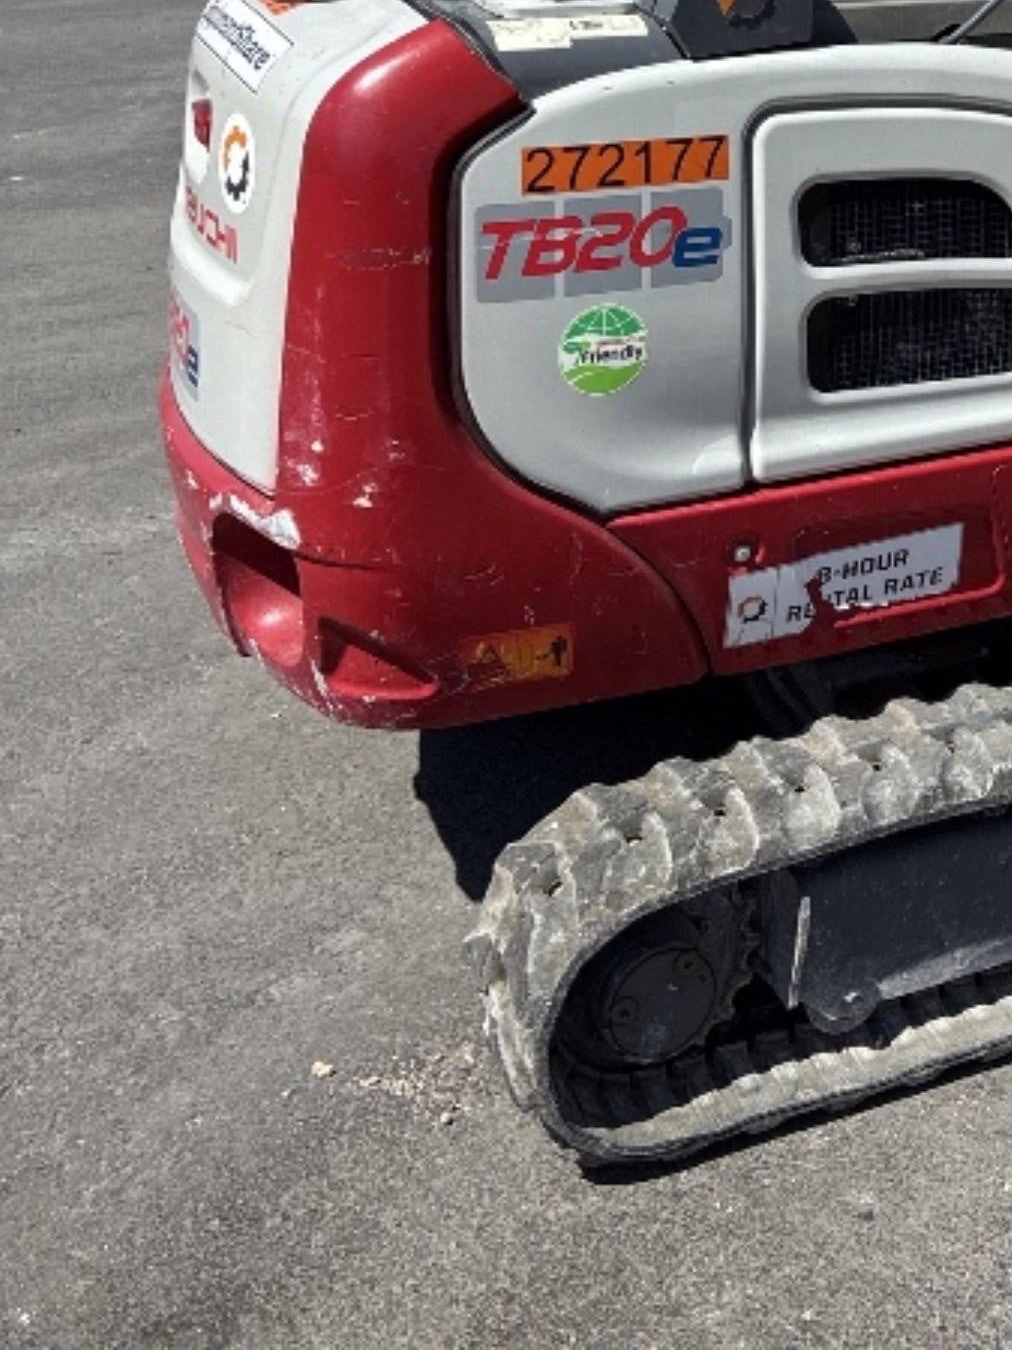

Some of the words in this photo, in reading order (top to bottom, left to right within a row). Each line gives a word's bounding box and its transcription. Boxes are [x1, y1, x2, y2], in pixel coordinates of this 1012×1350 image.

[525, 135, 727, 193] 272177
[481, 206, 723, 281] TB20e
[786, 587, 873, 622] RETAL
[884, 567, 943, 595] RATE
